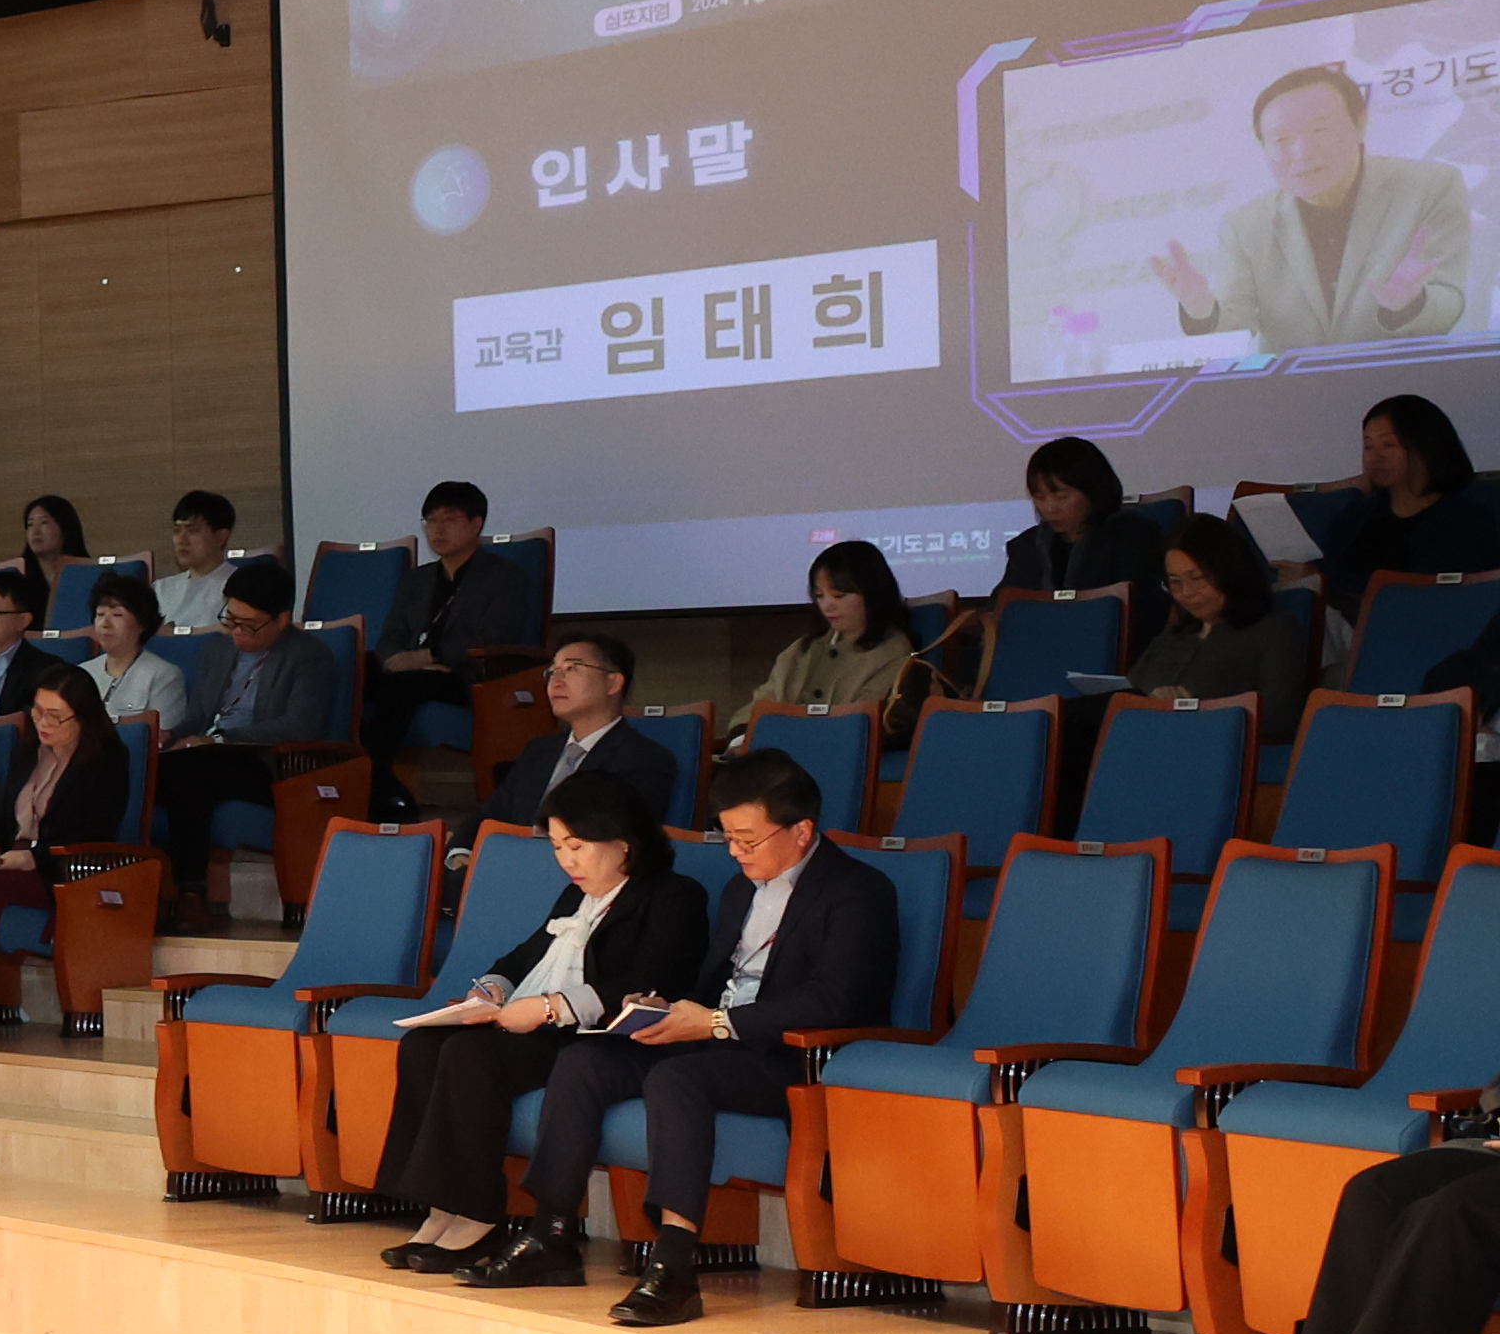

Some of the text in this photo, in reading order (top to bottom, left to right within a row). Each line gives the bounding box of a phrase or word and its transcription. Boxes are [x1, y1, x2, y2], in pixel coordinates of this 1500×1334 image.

[604, 3, 671, 30] 심포지엄
[531, 121, 754, 208] 인사말
[473, 272, 887, 377] 교육감 임태희
